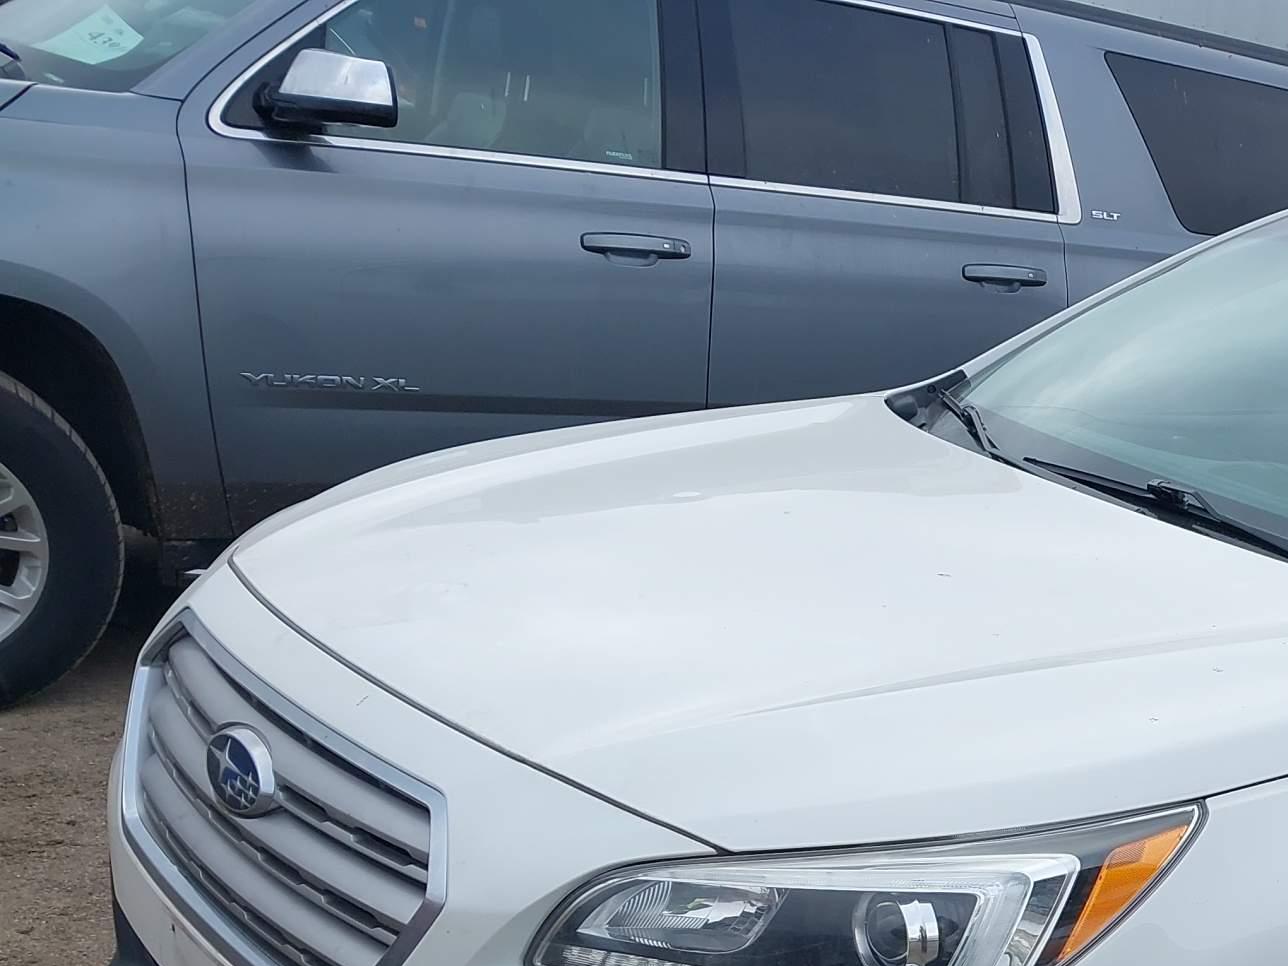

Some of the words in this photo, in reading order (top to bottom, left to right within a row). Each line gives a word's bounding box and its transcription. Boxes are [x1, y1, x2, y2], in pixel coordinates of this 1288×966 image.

[1091, 210, 1121, 221] SLT
[240, 372, 364, 388] YUKON
[371, 376, 420, 391] XL
